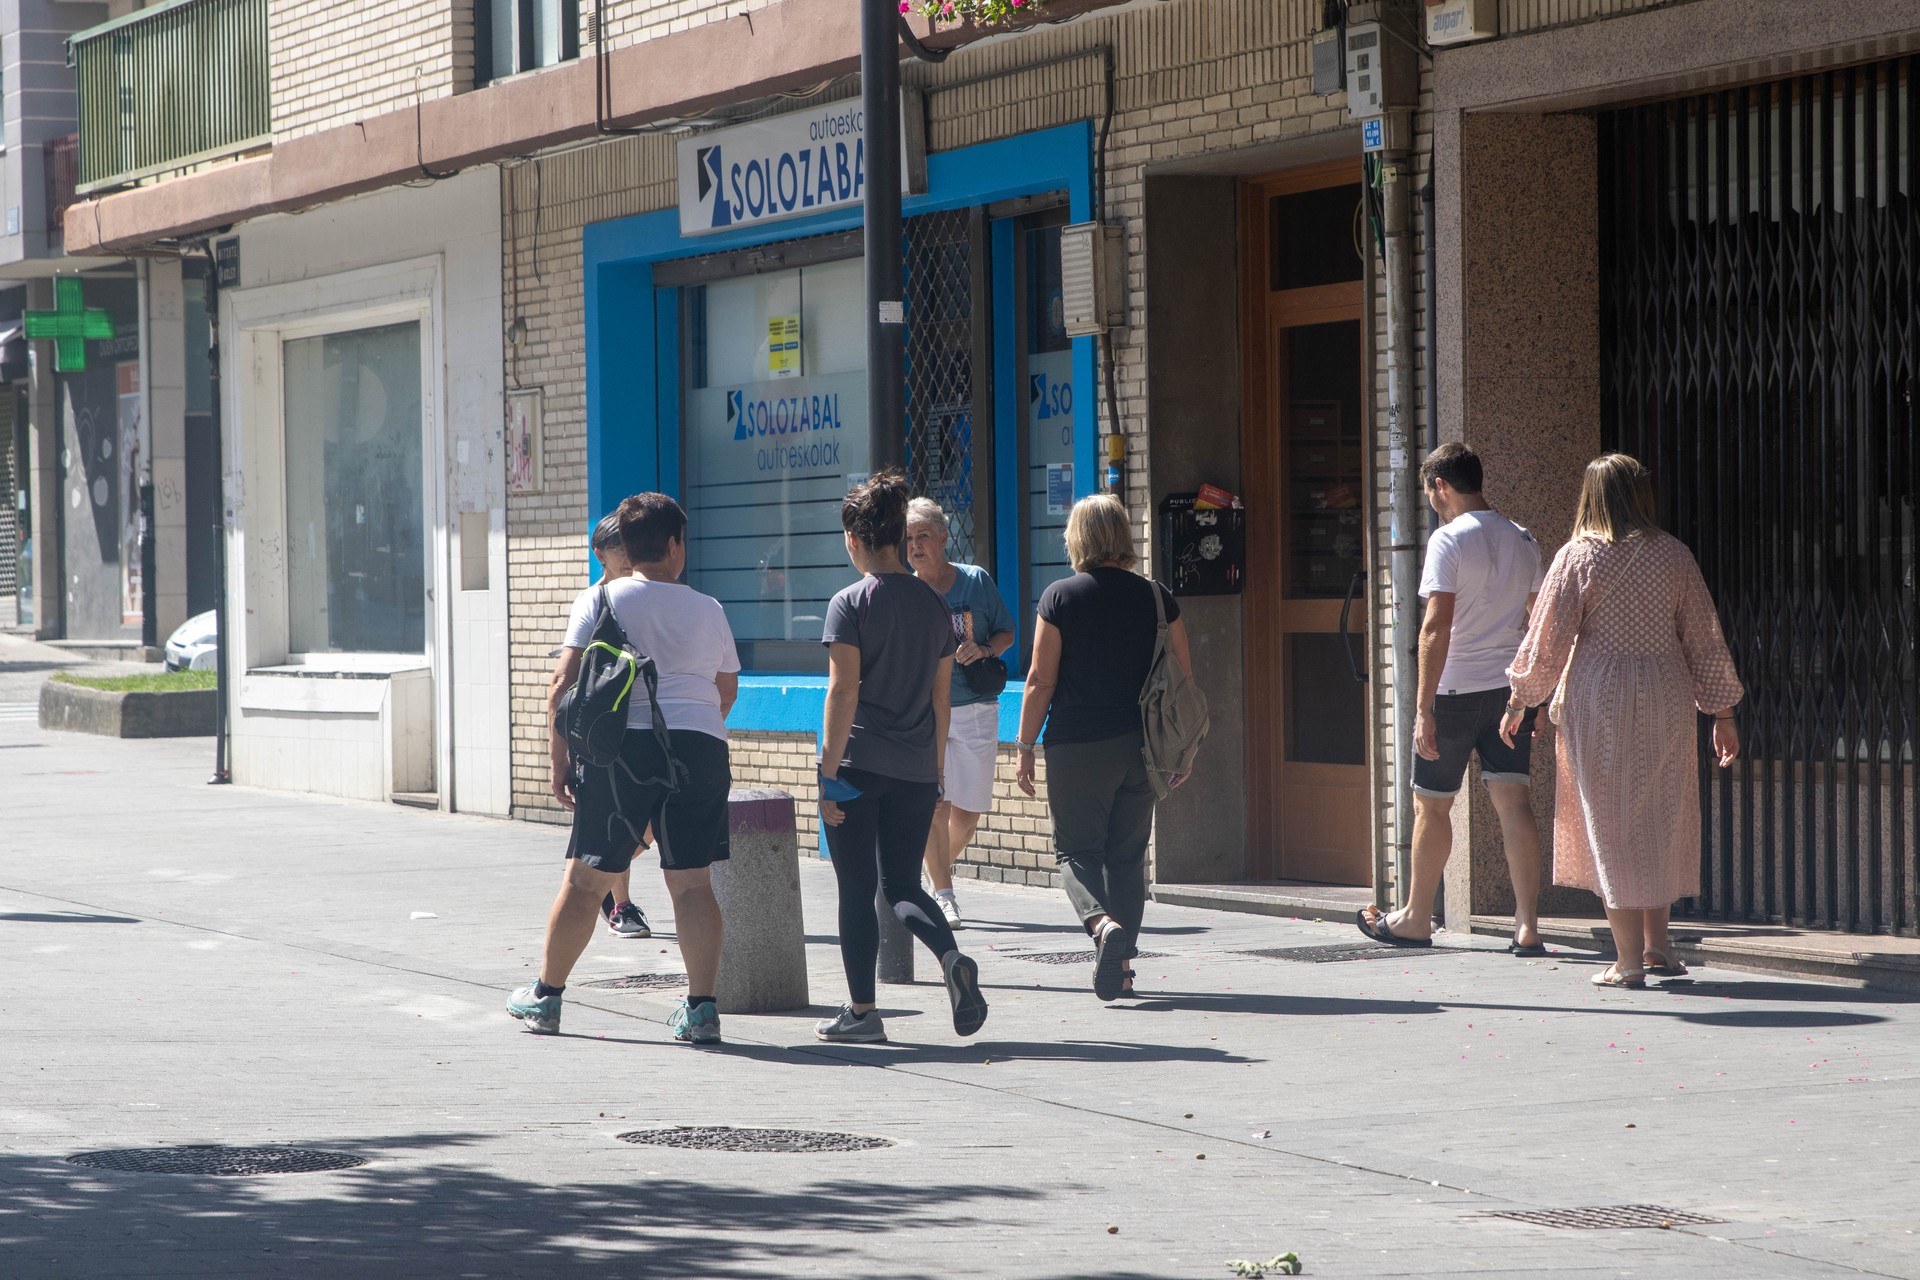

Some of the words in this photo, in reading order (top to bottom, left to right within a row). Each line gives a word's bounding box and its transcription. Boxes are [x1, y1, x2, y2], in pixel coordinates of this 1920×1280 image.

[748, 393, 841, 438] SOLOZABAL
[1051, 382, 1072, 416] SO
[757, 436, 841, 471] autoeskolak
